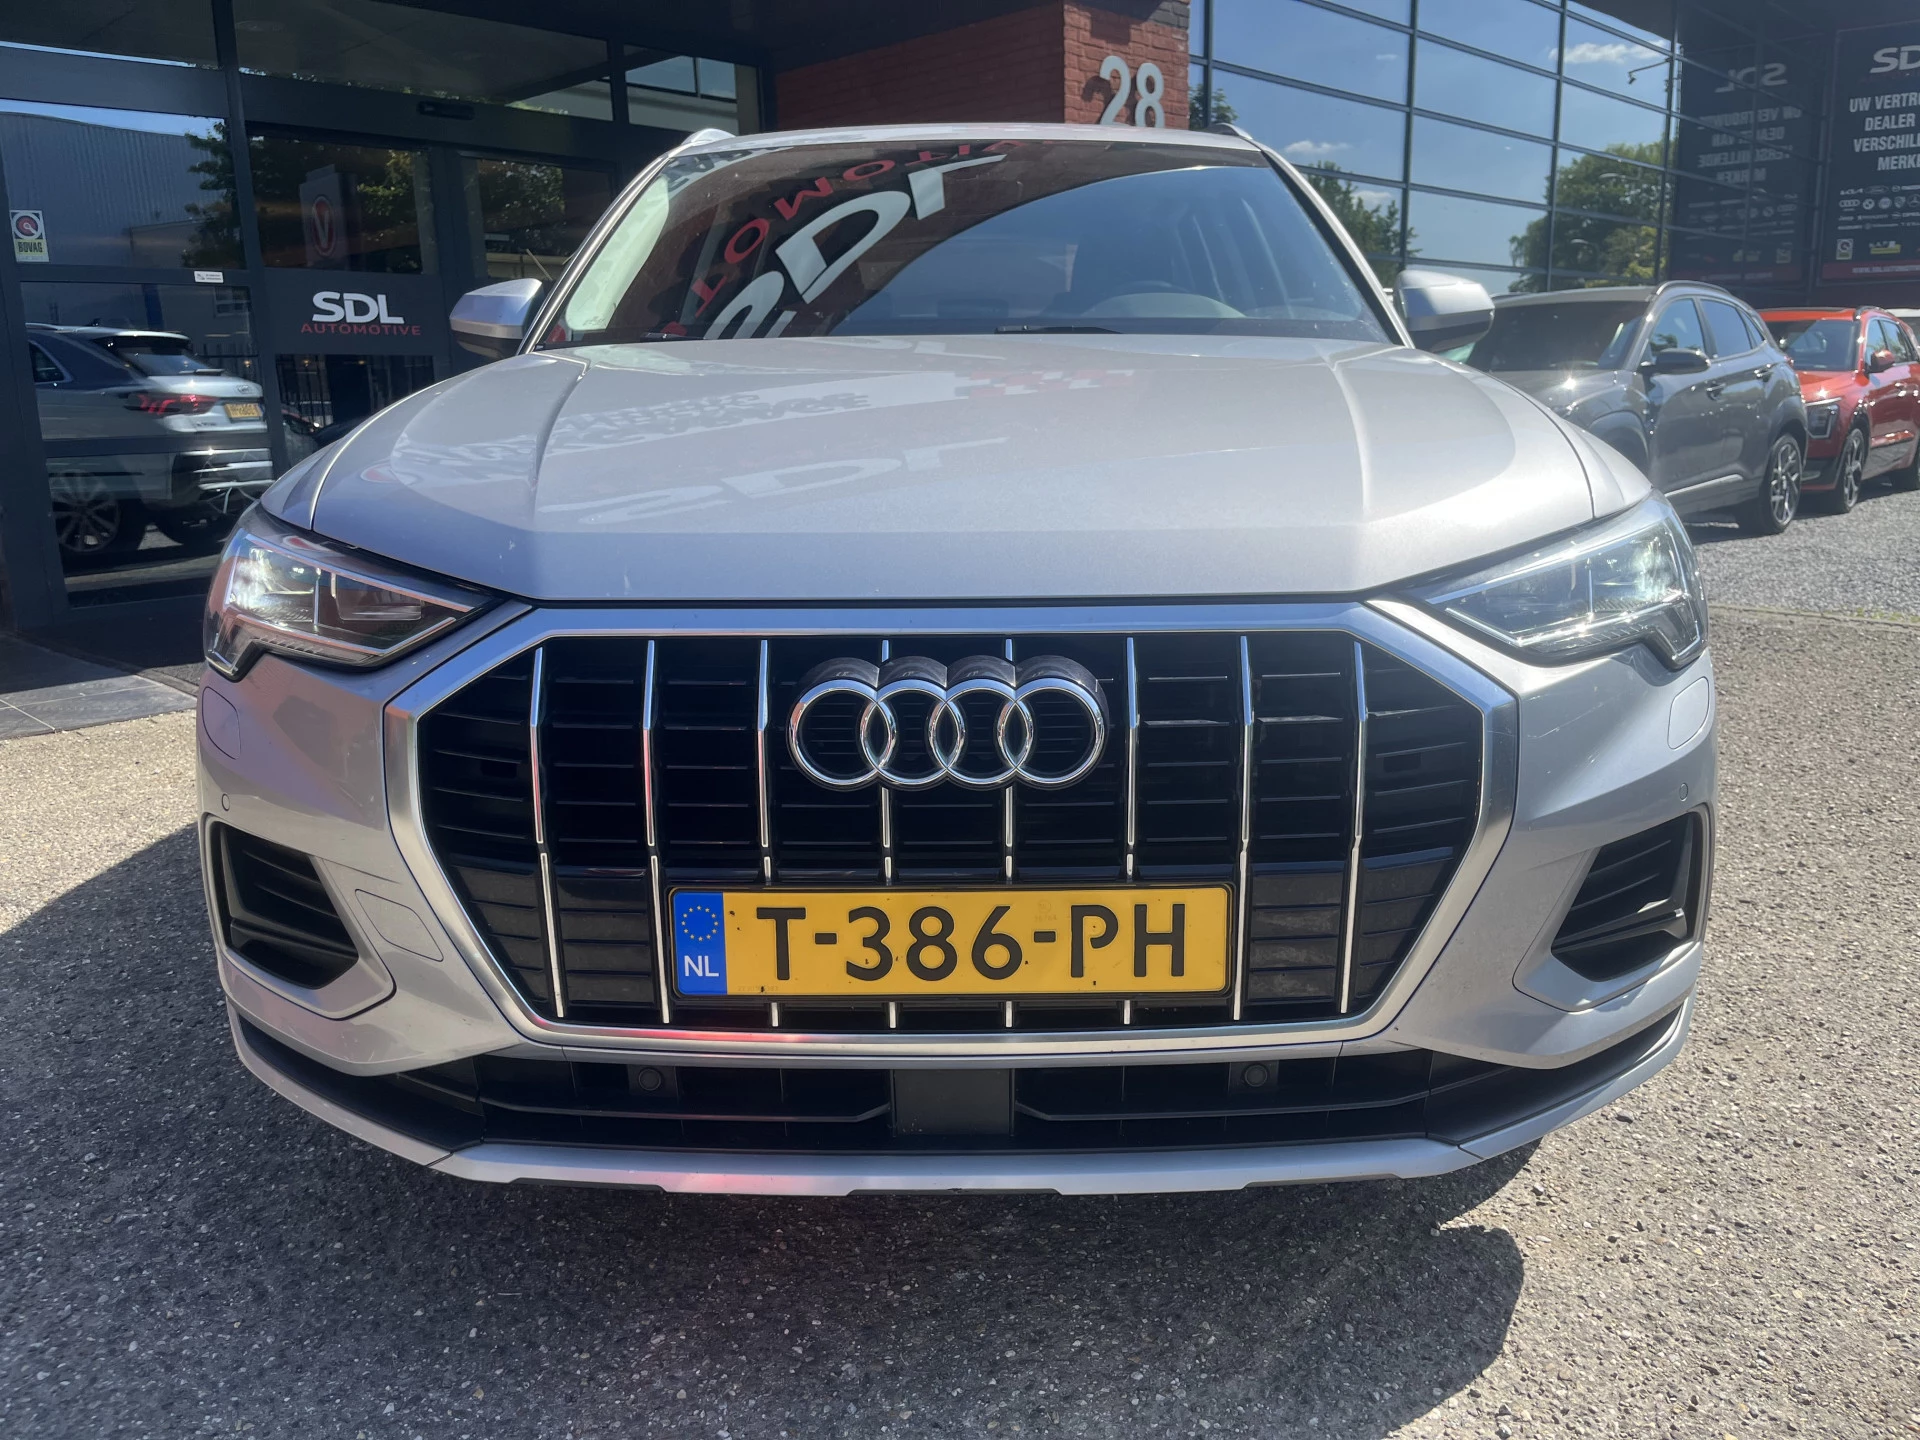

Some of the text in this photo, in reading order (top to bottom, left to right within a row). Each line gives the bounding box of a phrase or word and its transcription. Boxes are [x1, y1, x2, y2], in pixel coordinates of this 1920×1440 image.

[1099, 55, 1165, 128] 28
[1849, 97, 1871, 113] UW
[1864, 113, 1916, 131] DEALER
[18, 242, 43, 253] BOVAG
[312, 291, 405, 324] SDL
[301, 323, 422, 336] AUTOMOTIVE
[684, 903, 1186, 981] NL T-386-PH
